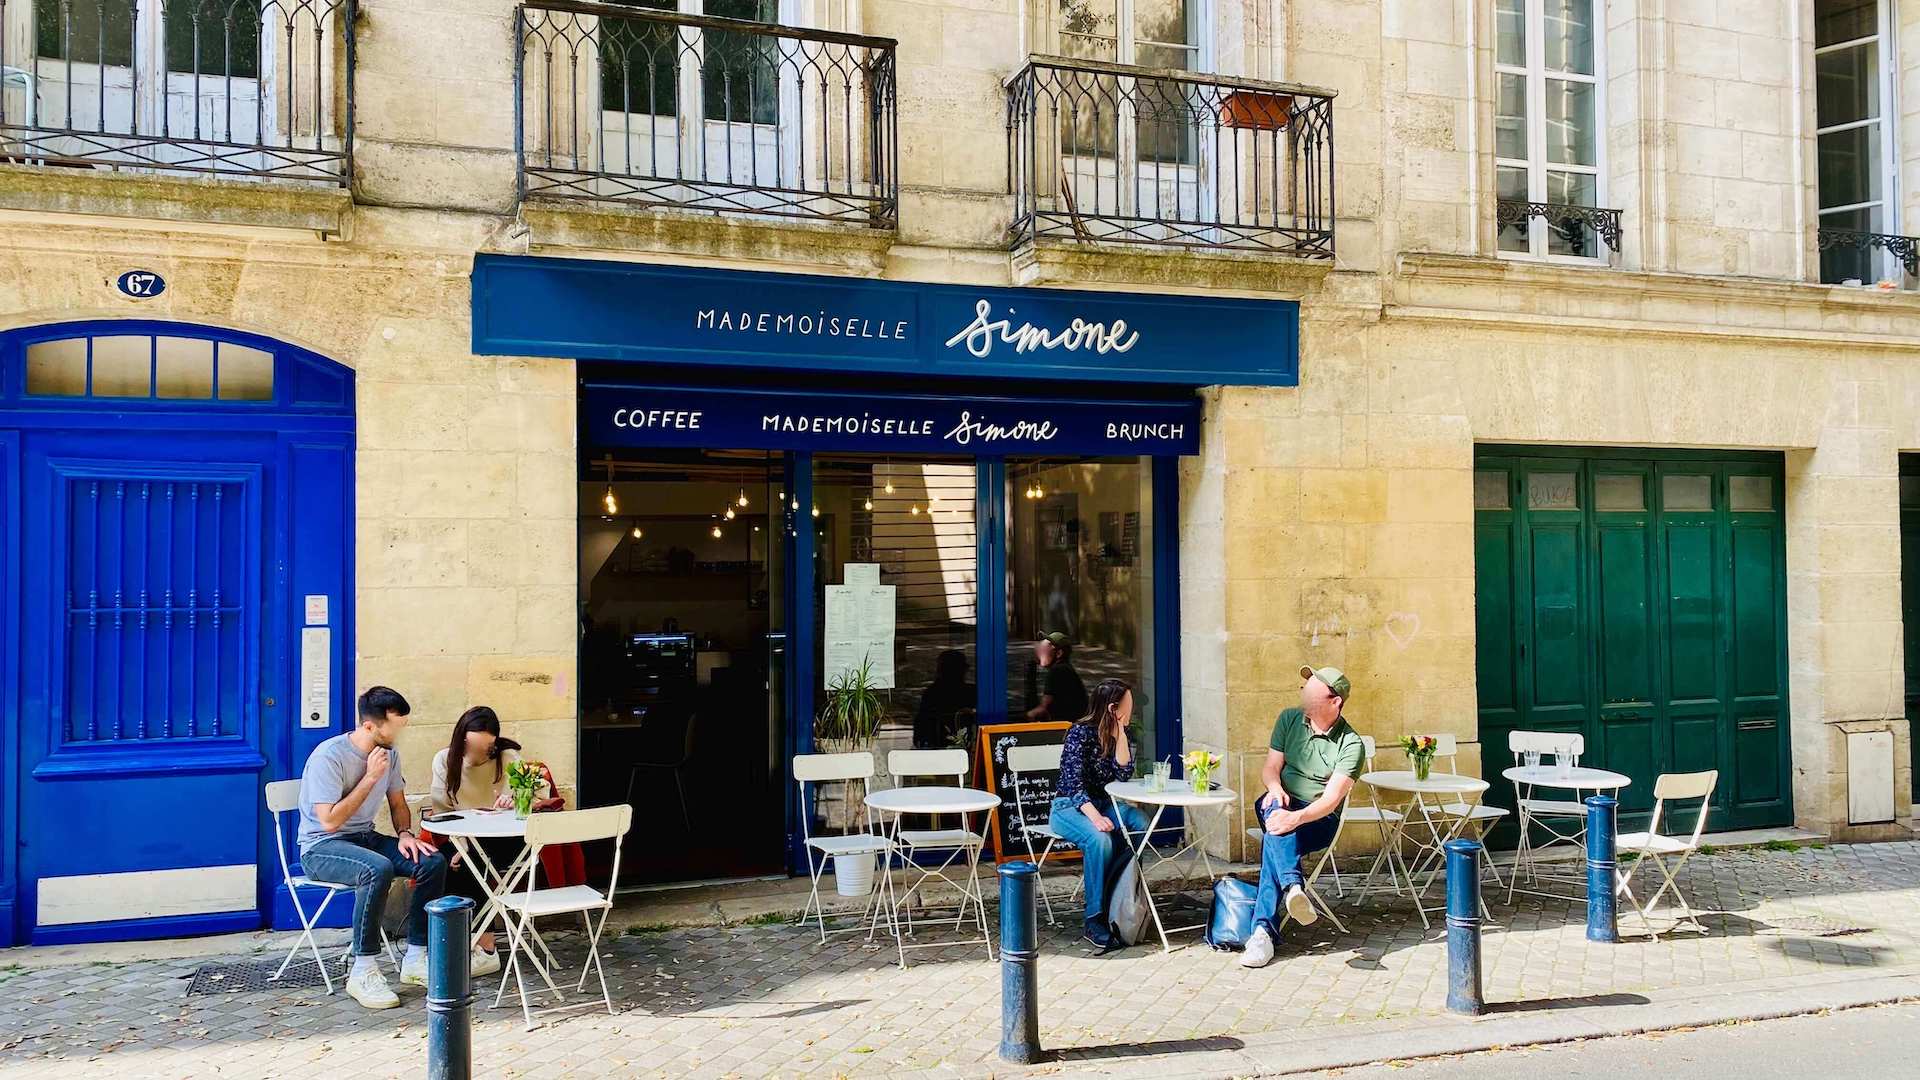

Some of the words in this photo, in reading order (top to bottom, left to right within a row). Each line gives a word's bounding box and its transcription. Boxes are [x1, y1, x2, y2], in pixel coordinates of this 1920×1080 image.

[127, 274, 156, 295] 67
[945, 299, 1140, 358] Simone
[613, 408, 702, 429] COFFEE
[943, 410, 1058, 445] Simone
[1106, 422, 1184, 442] BRUNCH
